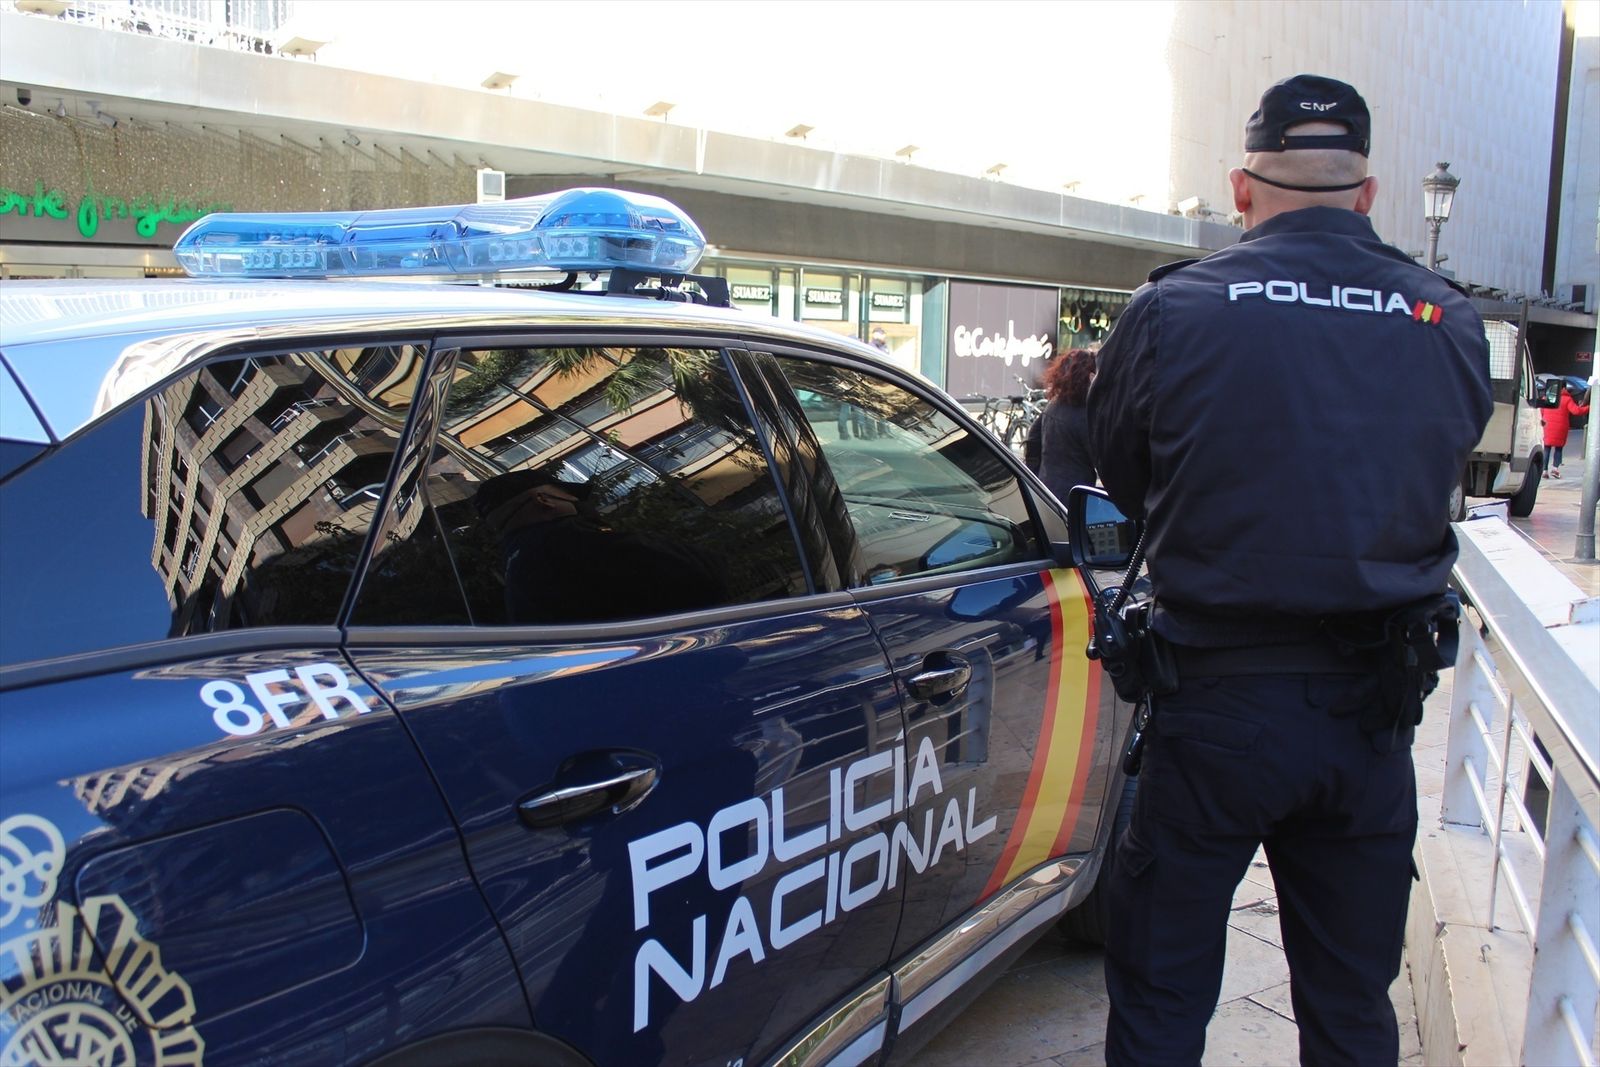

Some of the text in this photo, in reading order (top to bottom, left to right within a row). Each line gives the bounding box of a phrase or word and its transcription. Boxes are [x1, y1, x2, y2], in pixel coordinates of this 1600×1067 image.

[1299, 102, 1338, 112] CNP
[0, 179, 69, 219] orte
[732, 286, 770, 301] SUAREZ
[807, 290, 842, 304] SUAREZ
[1228, 280, 1413, 315] POLICIA
[200, 662, 371, 736] 8FR
[634, 786, 997, 1034] NACIONAL
